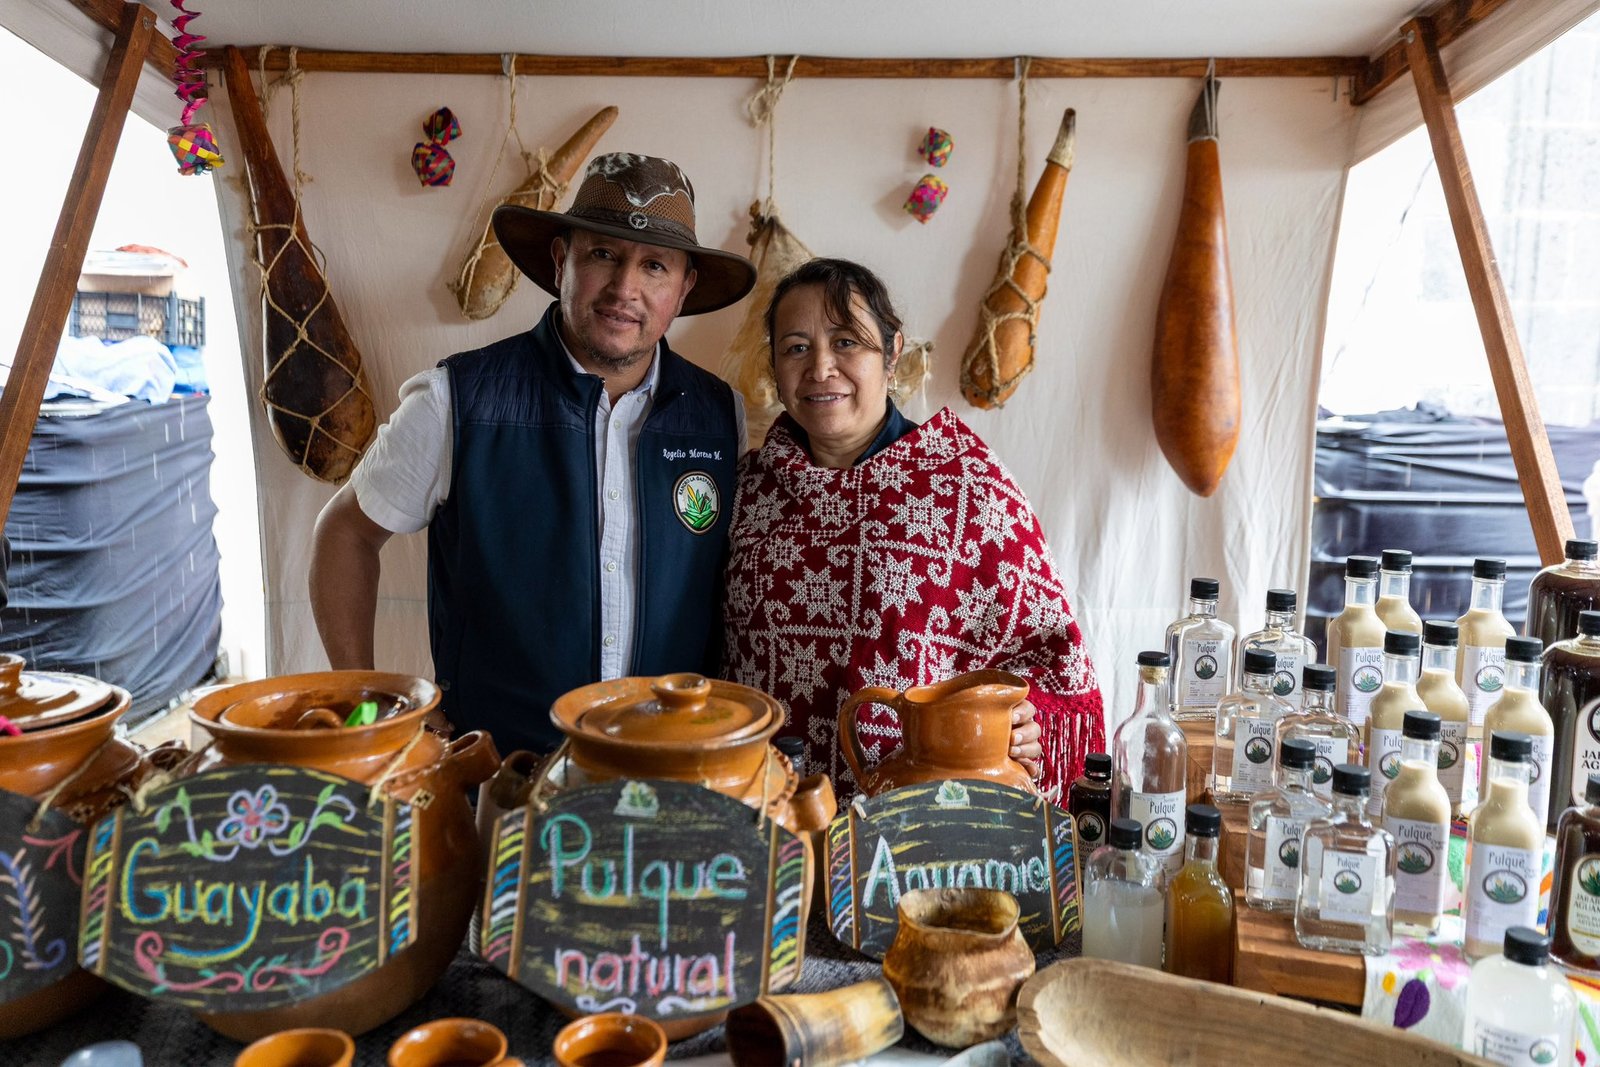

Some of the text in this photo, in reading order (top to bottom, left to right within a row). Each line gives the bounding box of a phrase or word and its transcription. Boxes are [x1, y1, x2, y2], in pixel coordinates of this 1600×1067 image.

[662, 448, 686, 461] Rogelio
[689, 448, 712, 459] Moreno
[1197, 643, 1216, 654] Pulque
[1277, 659, 1294, 670] ulque
[1355, 652, 1381, 665] Pulque
[1248, 722, 1271, 737] Pulque
[1149, 801, 1176, 818] Pulque
[1398, 825, 1432, 842] Pulque
[1337, 857, 1360, 870] Pulque
[1488, 852, 1525, 871] Pulque
[540, 813, 747, 950] Pulque
[120, 836, 368, 963] Guayaba
[555, 931, 736, 1001] natural
